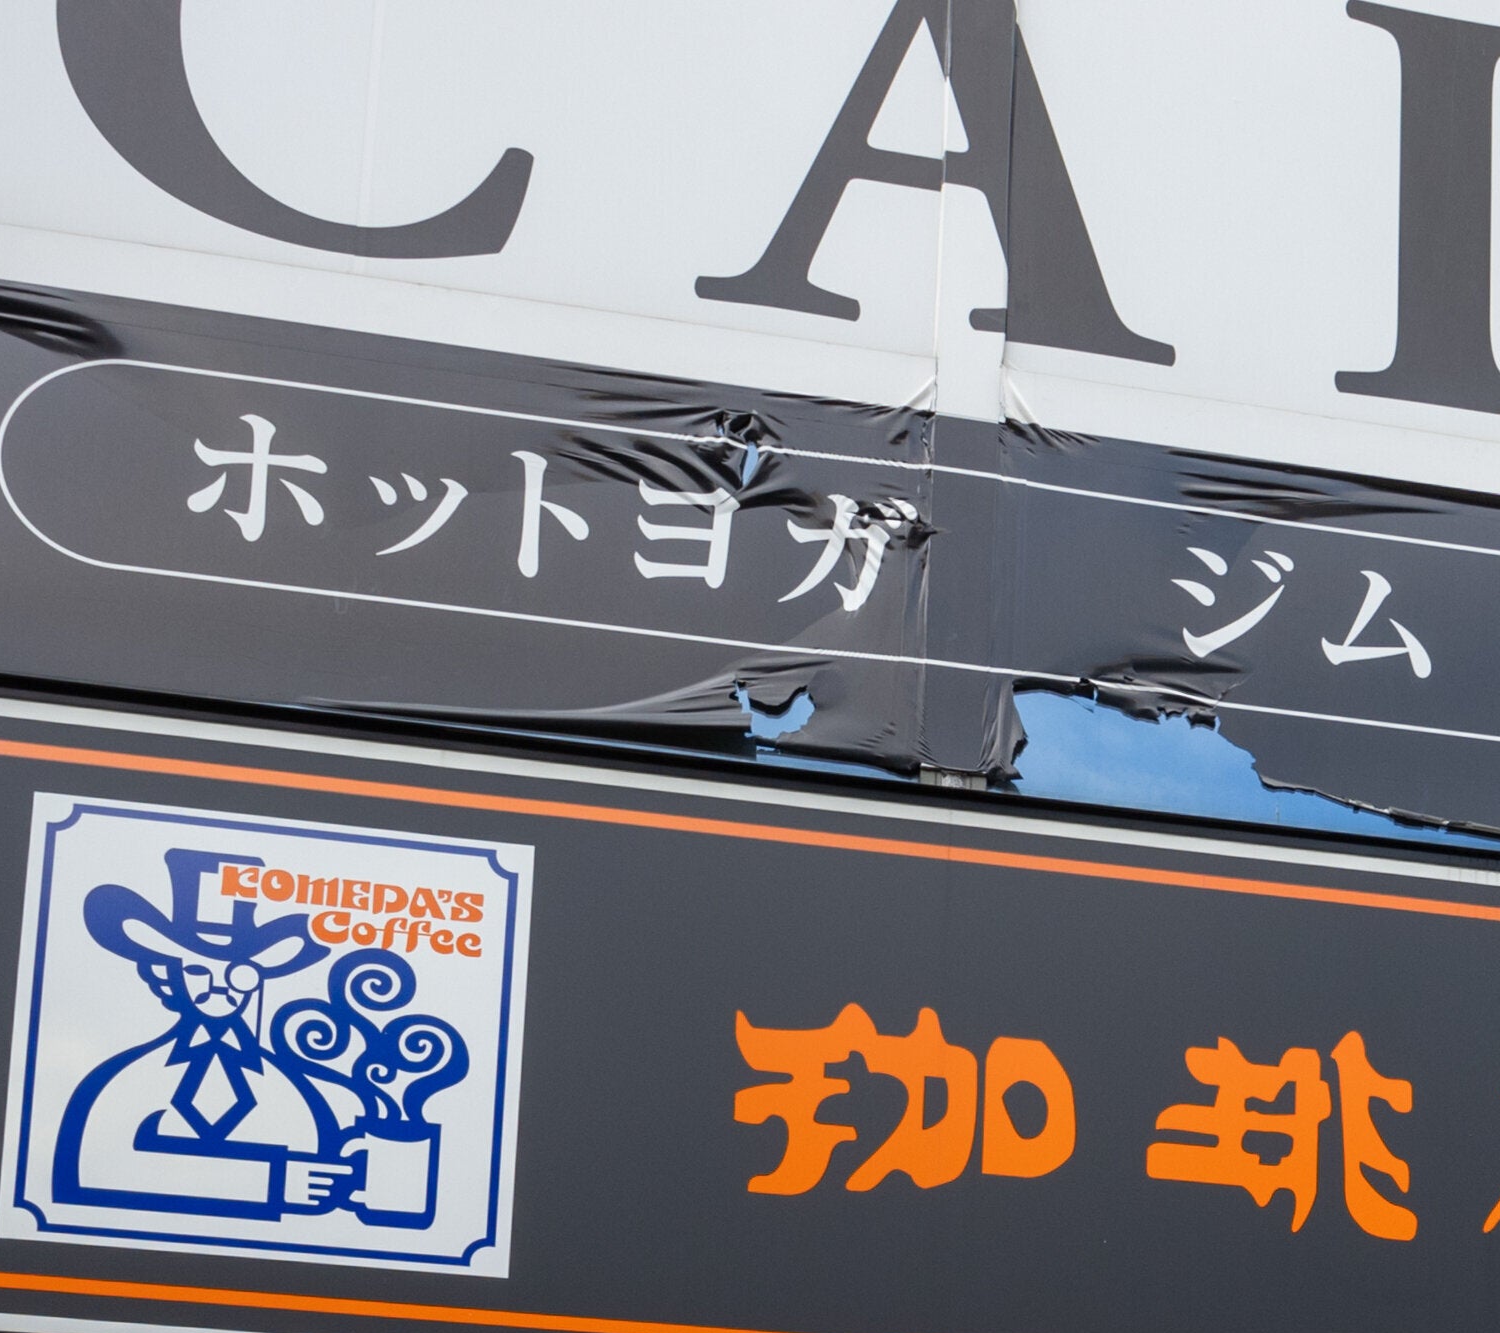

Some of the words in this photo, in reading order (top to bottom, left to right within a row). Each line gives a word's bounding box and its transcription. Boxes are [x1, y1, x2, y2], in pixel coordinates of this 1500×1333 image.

[187, 412, 932, 612] ホットヨガ
[1171, 545, 1433, 679] ジム
[219, 862, 486, 925] KOMEDA'S
[310, 908, 486, 958] Coffee
